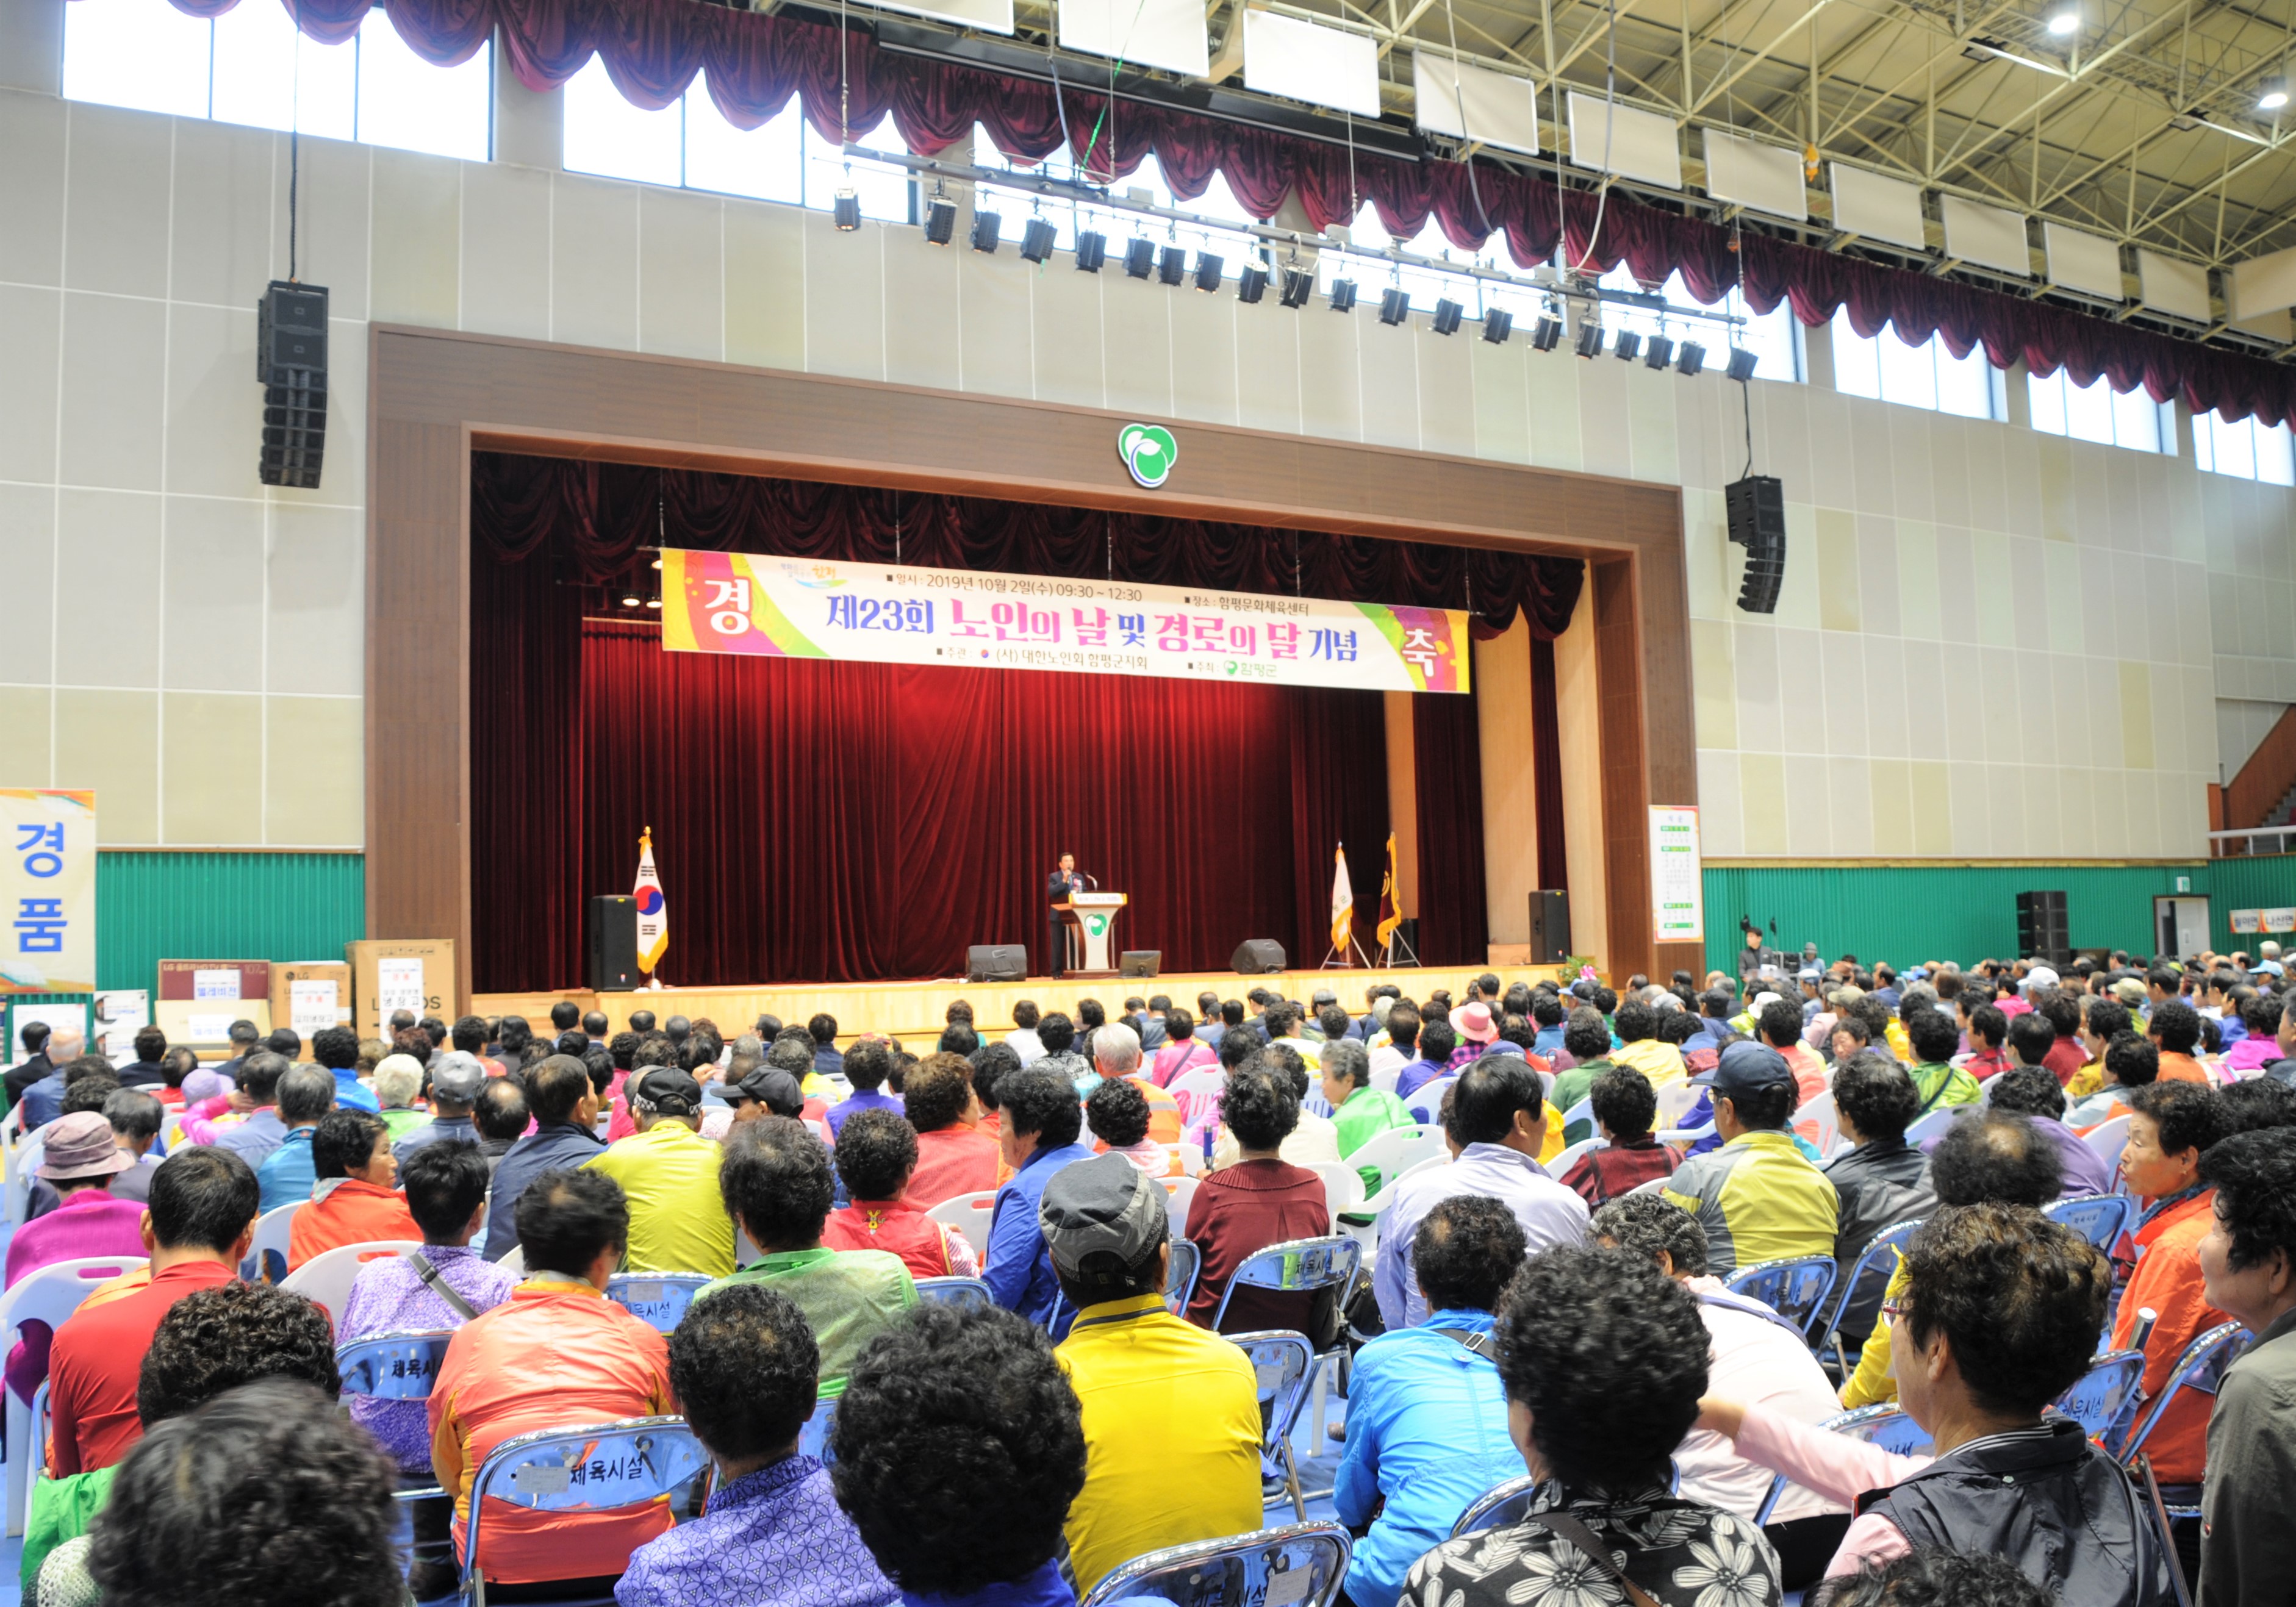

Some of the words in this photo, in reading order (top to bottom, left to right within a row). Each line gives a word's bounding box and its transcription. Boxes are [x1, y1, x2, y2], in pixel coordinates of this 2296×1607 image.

[896, 573, 917, 586] 일시
[927, 574, 974, 591] 2019년
[978, 578, 1006, 593] 10월
[1010, 579, 1053, 596] 2일(수)
[1056, 583, 1094, 598] 09:30
[1108, 588, 1143, 602] 12:30
[705, 579, 751, 634] 경
[1193, 595, 1210, 607] 장소
[1219, 596, 1309, 616] 함평문화체육센터
[827, 594, 934, 634] 제23회
[949, 598, 1061, 643] 노인의
[1071, 607, 1111, 646] 날
[1117, 613, 1146, 648] 및
[1154, 613, 1257, 657] 경로의
[1266, 621, 1302, 660] 달
[1308, 627, 1358, 662] 기념
[996, 648, 1018, 663] (사)
[1022, 649, 1084, 667] 대한노인회
[1088, 653, 1148, 670] 함평군지회
[1401, 628, 1438, 678] 축
[1241, 662, 1277, 678] 함평군
